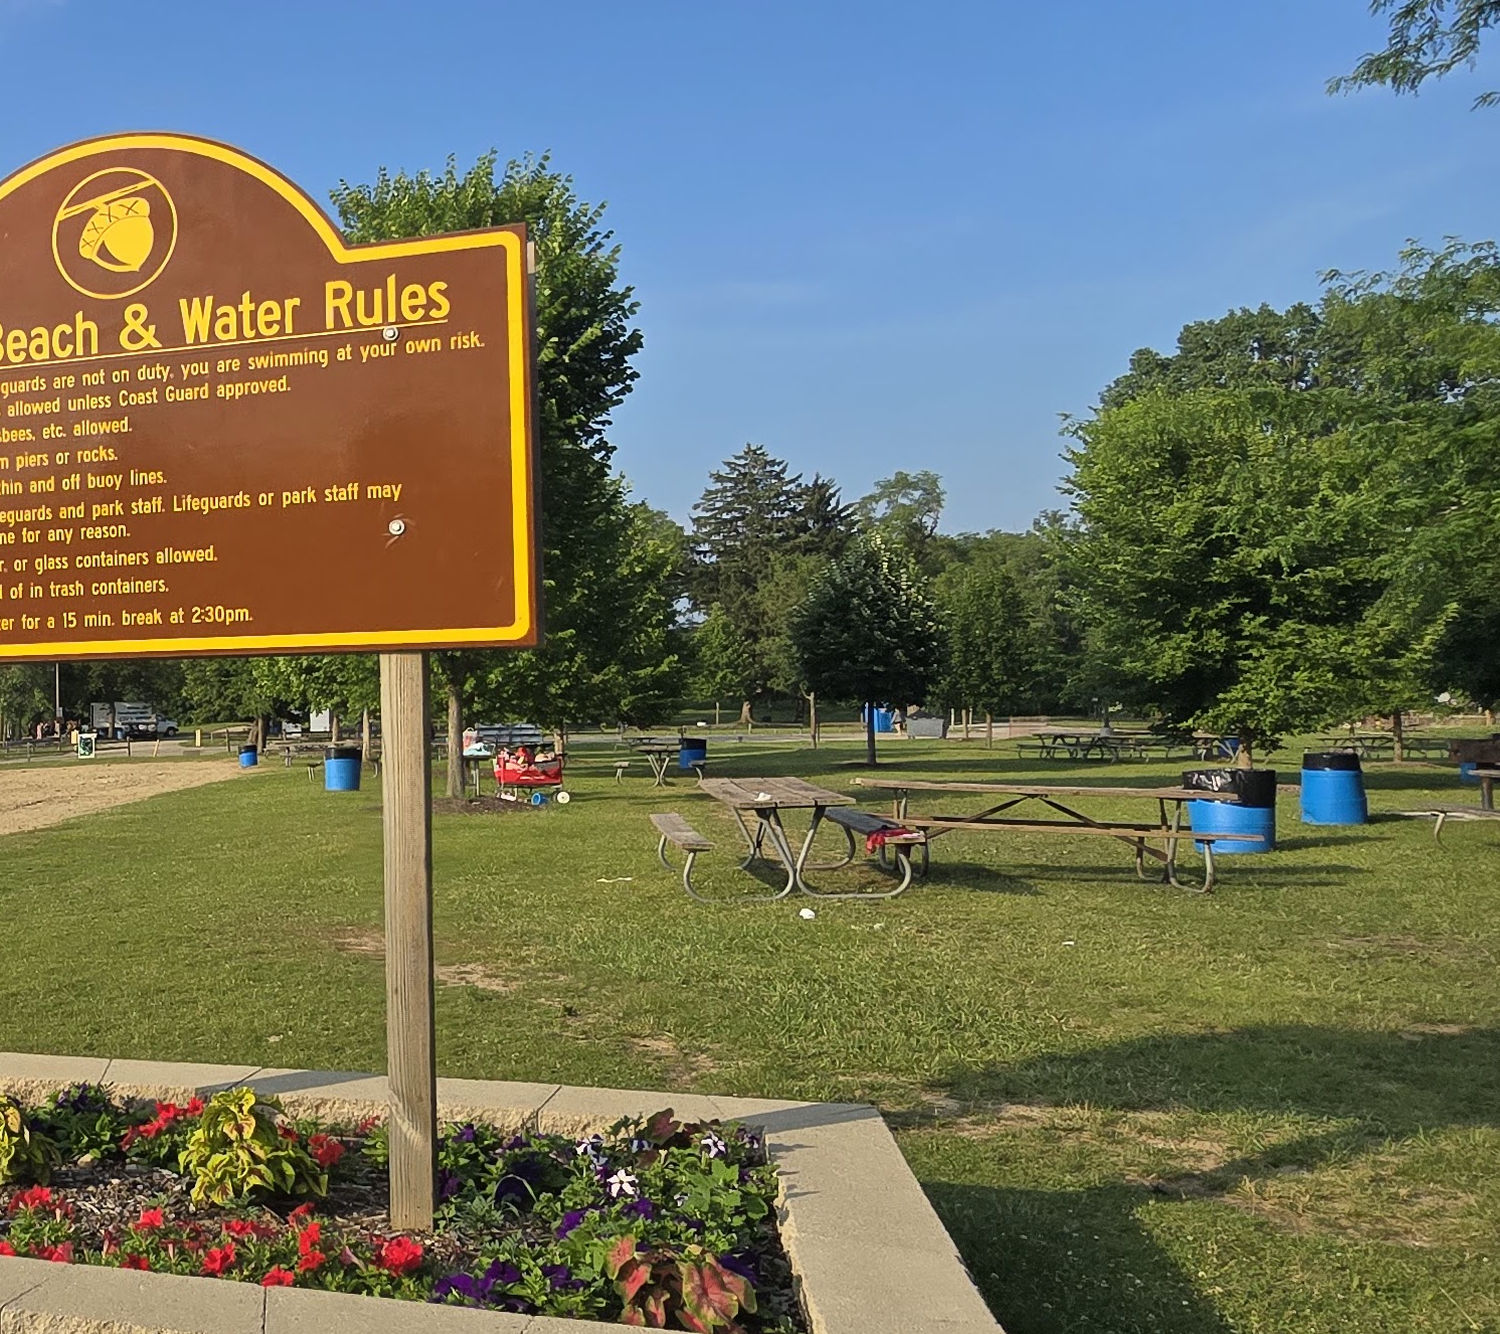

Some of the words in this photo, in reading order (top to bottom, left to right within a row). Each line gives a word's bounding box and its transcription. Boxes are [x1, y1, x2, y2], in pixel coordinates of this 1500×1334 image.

[120, 304, 162, 350] &
[179, 291, 300, 344] Water
[326, 274, 450, 329] Rules
[53, 375, 75, 388] are
[82, 369, 105, 386] not
[112, 370, 129, 382] on
[138, 363, 174, 382] duty,
[181, 362, 209, 380] you
[217, 359, 240, 372] are
[248, 348, 328, 369] swimming
[337, 344, 352, 360] at
[360, 343, 397, 362] your
[406, 338, 441, 353] own
[451, 331, 485, 349] risk.
[8, 397, 60, 417] allowed
[68, 394, 111, 411] unless
[119, 387, 158, 406] Coast
[166, 383, 208, 402] Guard
[217, 375, 291, 400] approved.
[43, 423, 66, 439] etc.
[73, 416, 132, 436] allowed.
[16, 452, 48, 471] piers
[56, 452, 69, 464] or
[77, 446, 118, 463] rocks.
[30, 476, 54, 493] and
[62, 474, 80, 490] off
[88, 473, 123, 490] buoy
[131, 469, 167, 485] lines.
[59, 502, 84, 518] and
[92, 500, 124, 520] park
[131, 496, 165, 514] staff.
[174, 491, 250, 514] Lifeguards
[259, 493, 274, 505] or
[283, 486, 316, 508] park
[325, 483, 358, 501] staff
[367, 484, 402, 501] may
[22, 527, 40, 542] for
[48, 528, 73, 544] any
[81, 525, 130, 539] reason.
[14, 559, 28, 571] or
[35, 554, 68, 575] glass
[76, 550, 149, 568] containers
[156, 545, 217, 564] allowed.
[10, 583, 23, 599] of
[30, 582, 42, 598] in
[50, 580, 83, 597] trash
[92, 577, 169, 595] containers.
[21, 614, 40, 629] for
[47, 617, 54, 628] a
[63, 612, 76, 628] 15
[85, 611, 115, 627] min.
[122, 609, 162, 625] break
[170, 608, 184, 623] at
[192, 606, 253, 625] 2:30pm.
